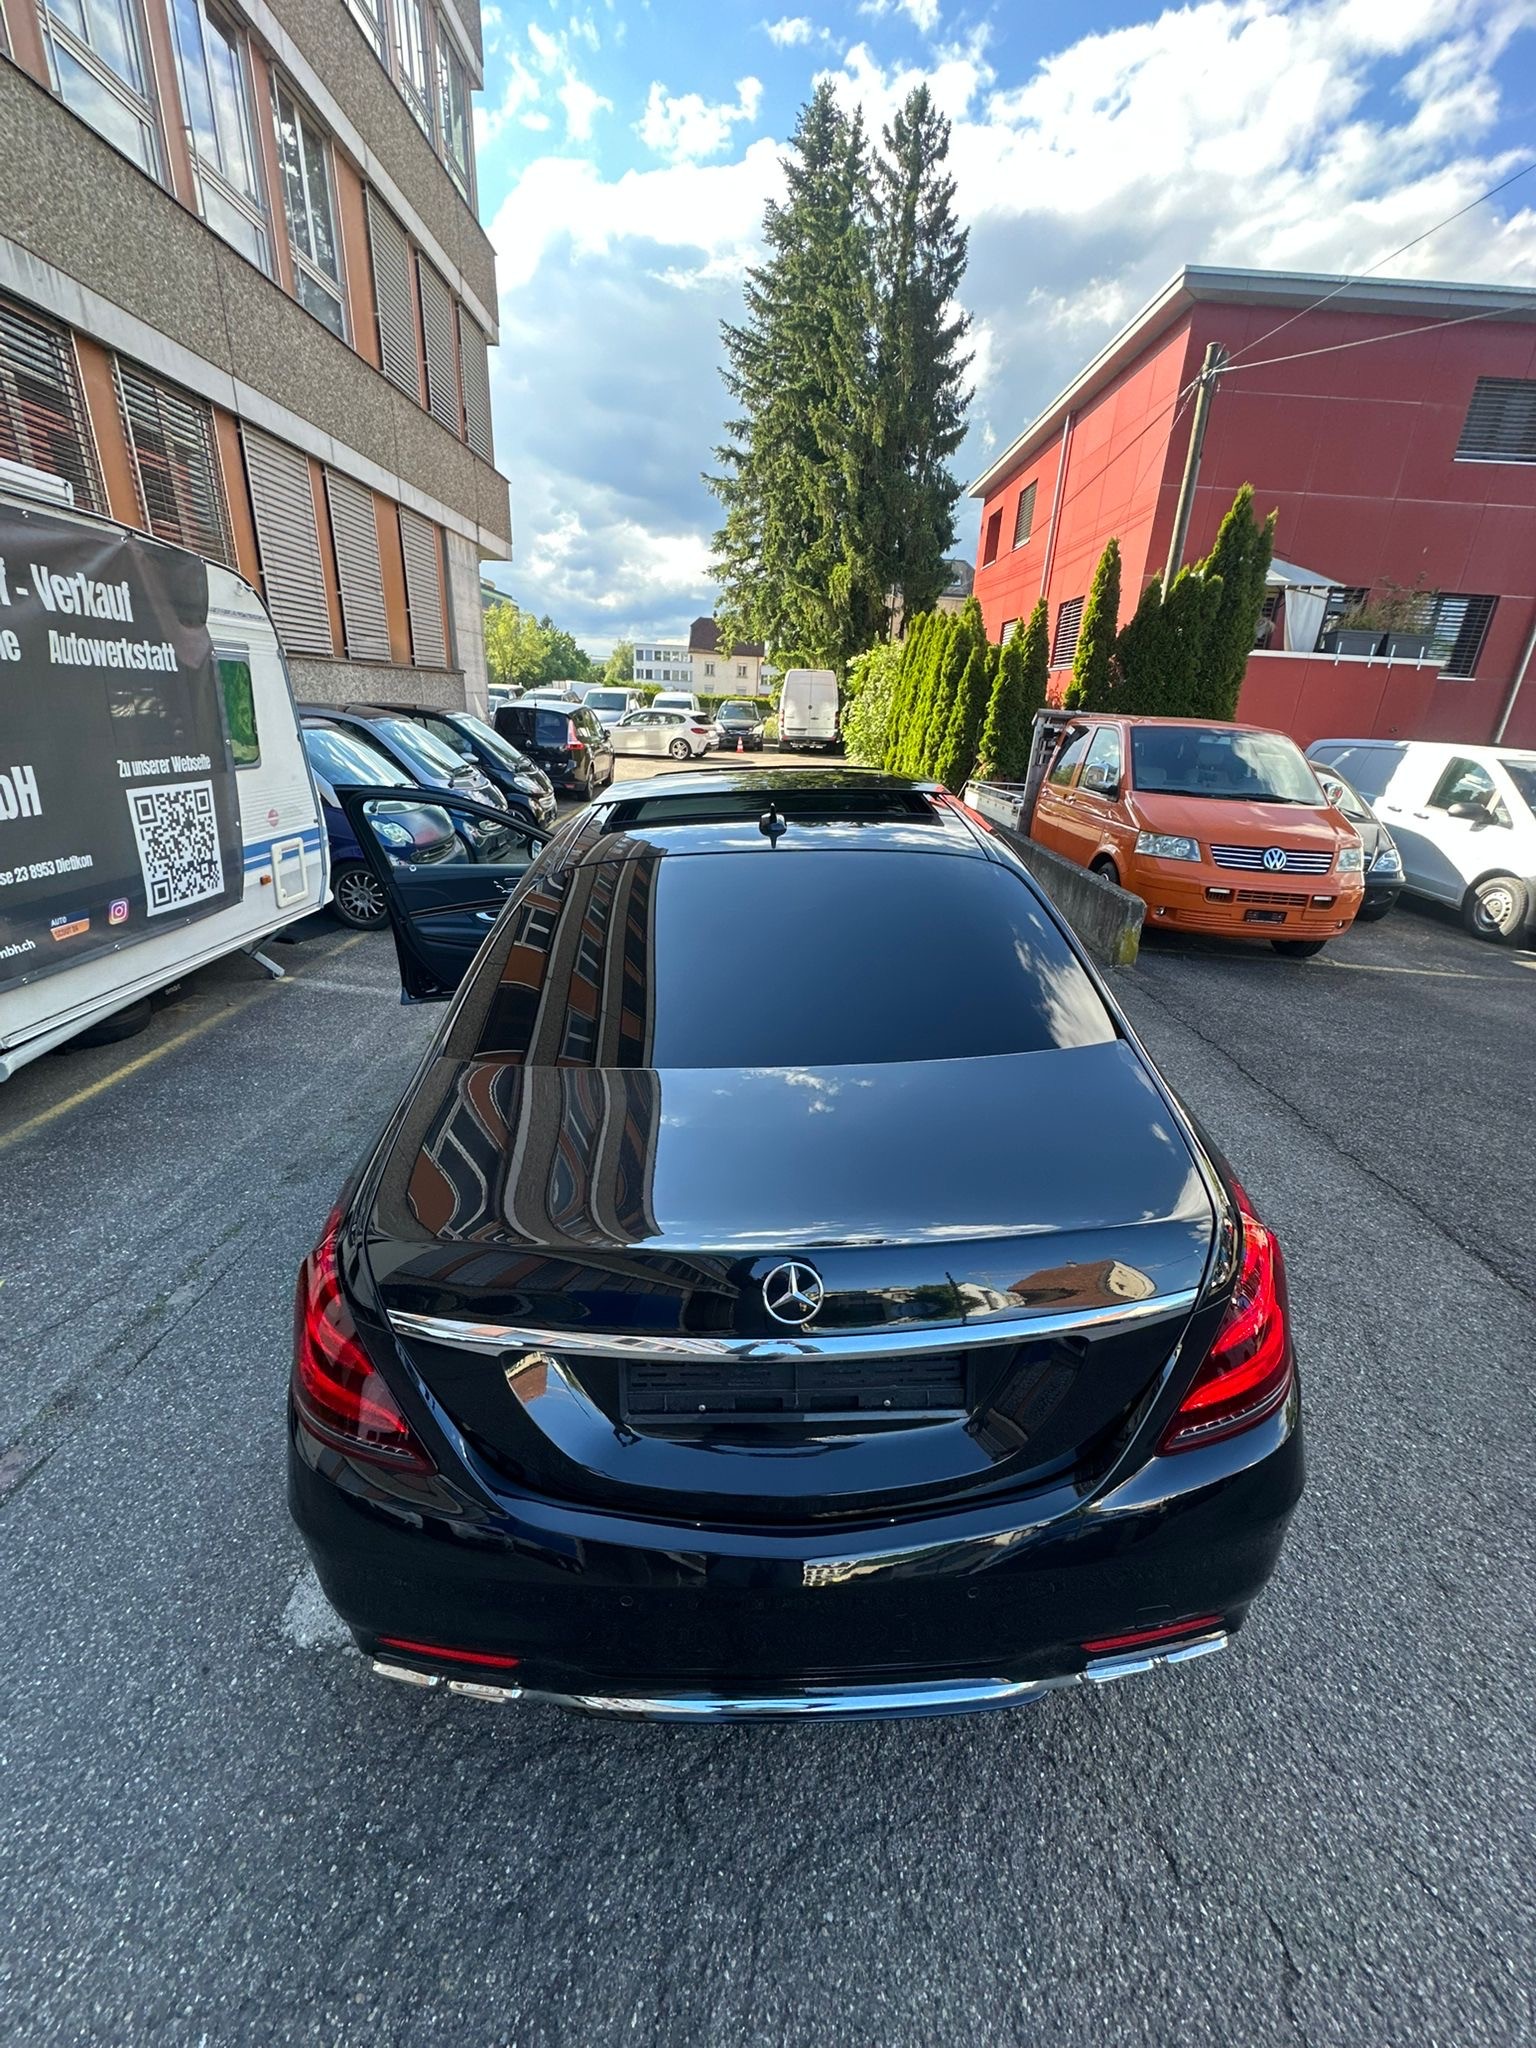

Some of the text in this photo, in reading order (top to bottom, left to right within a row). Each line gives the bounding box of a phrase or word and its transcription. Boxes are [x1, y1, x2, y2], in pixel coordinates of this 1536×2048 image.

[30, 563, 134, 622] Verkauf
[48, 629, 178, 672] Autowerkstatt
[116, 753, 211, 778] Zu unserer Webseite
[14, 866, 29, 883] 23
[29, 860, 56, 880] 8953
[55, 854, 94, 874] Dietikon
[1263, 847, 1287, 871] VW
[51, 916, 67, 927] AUTO
